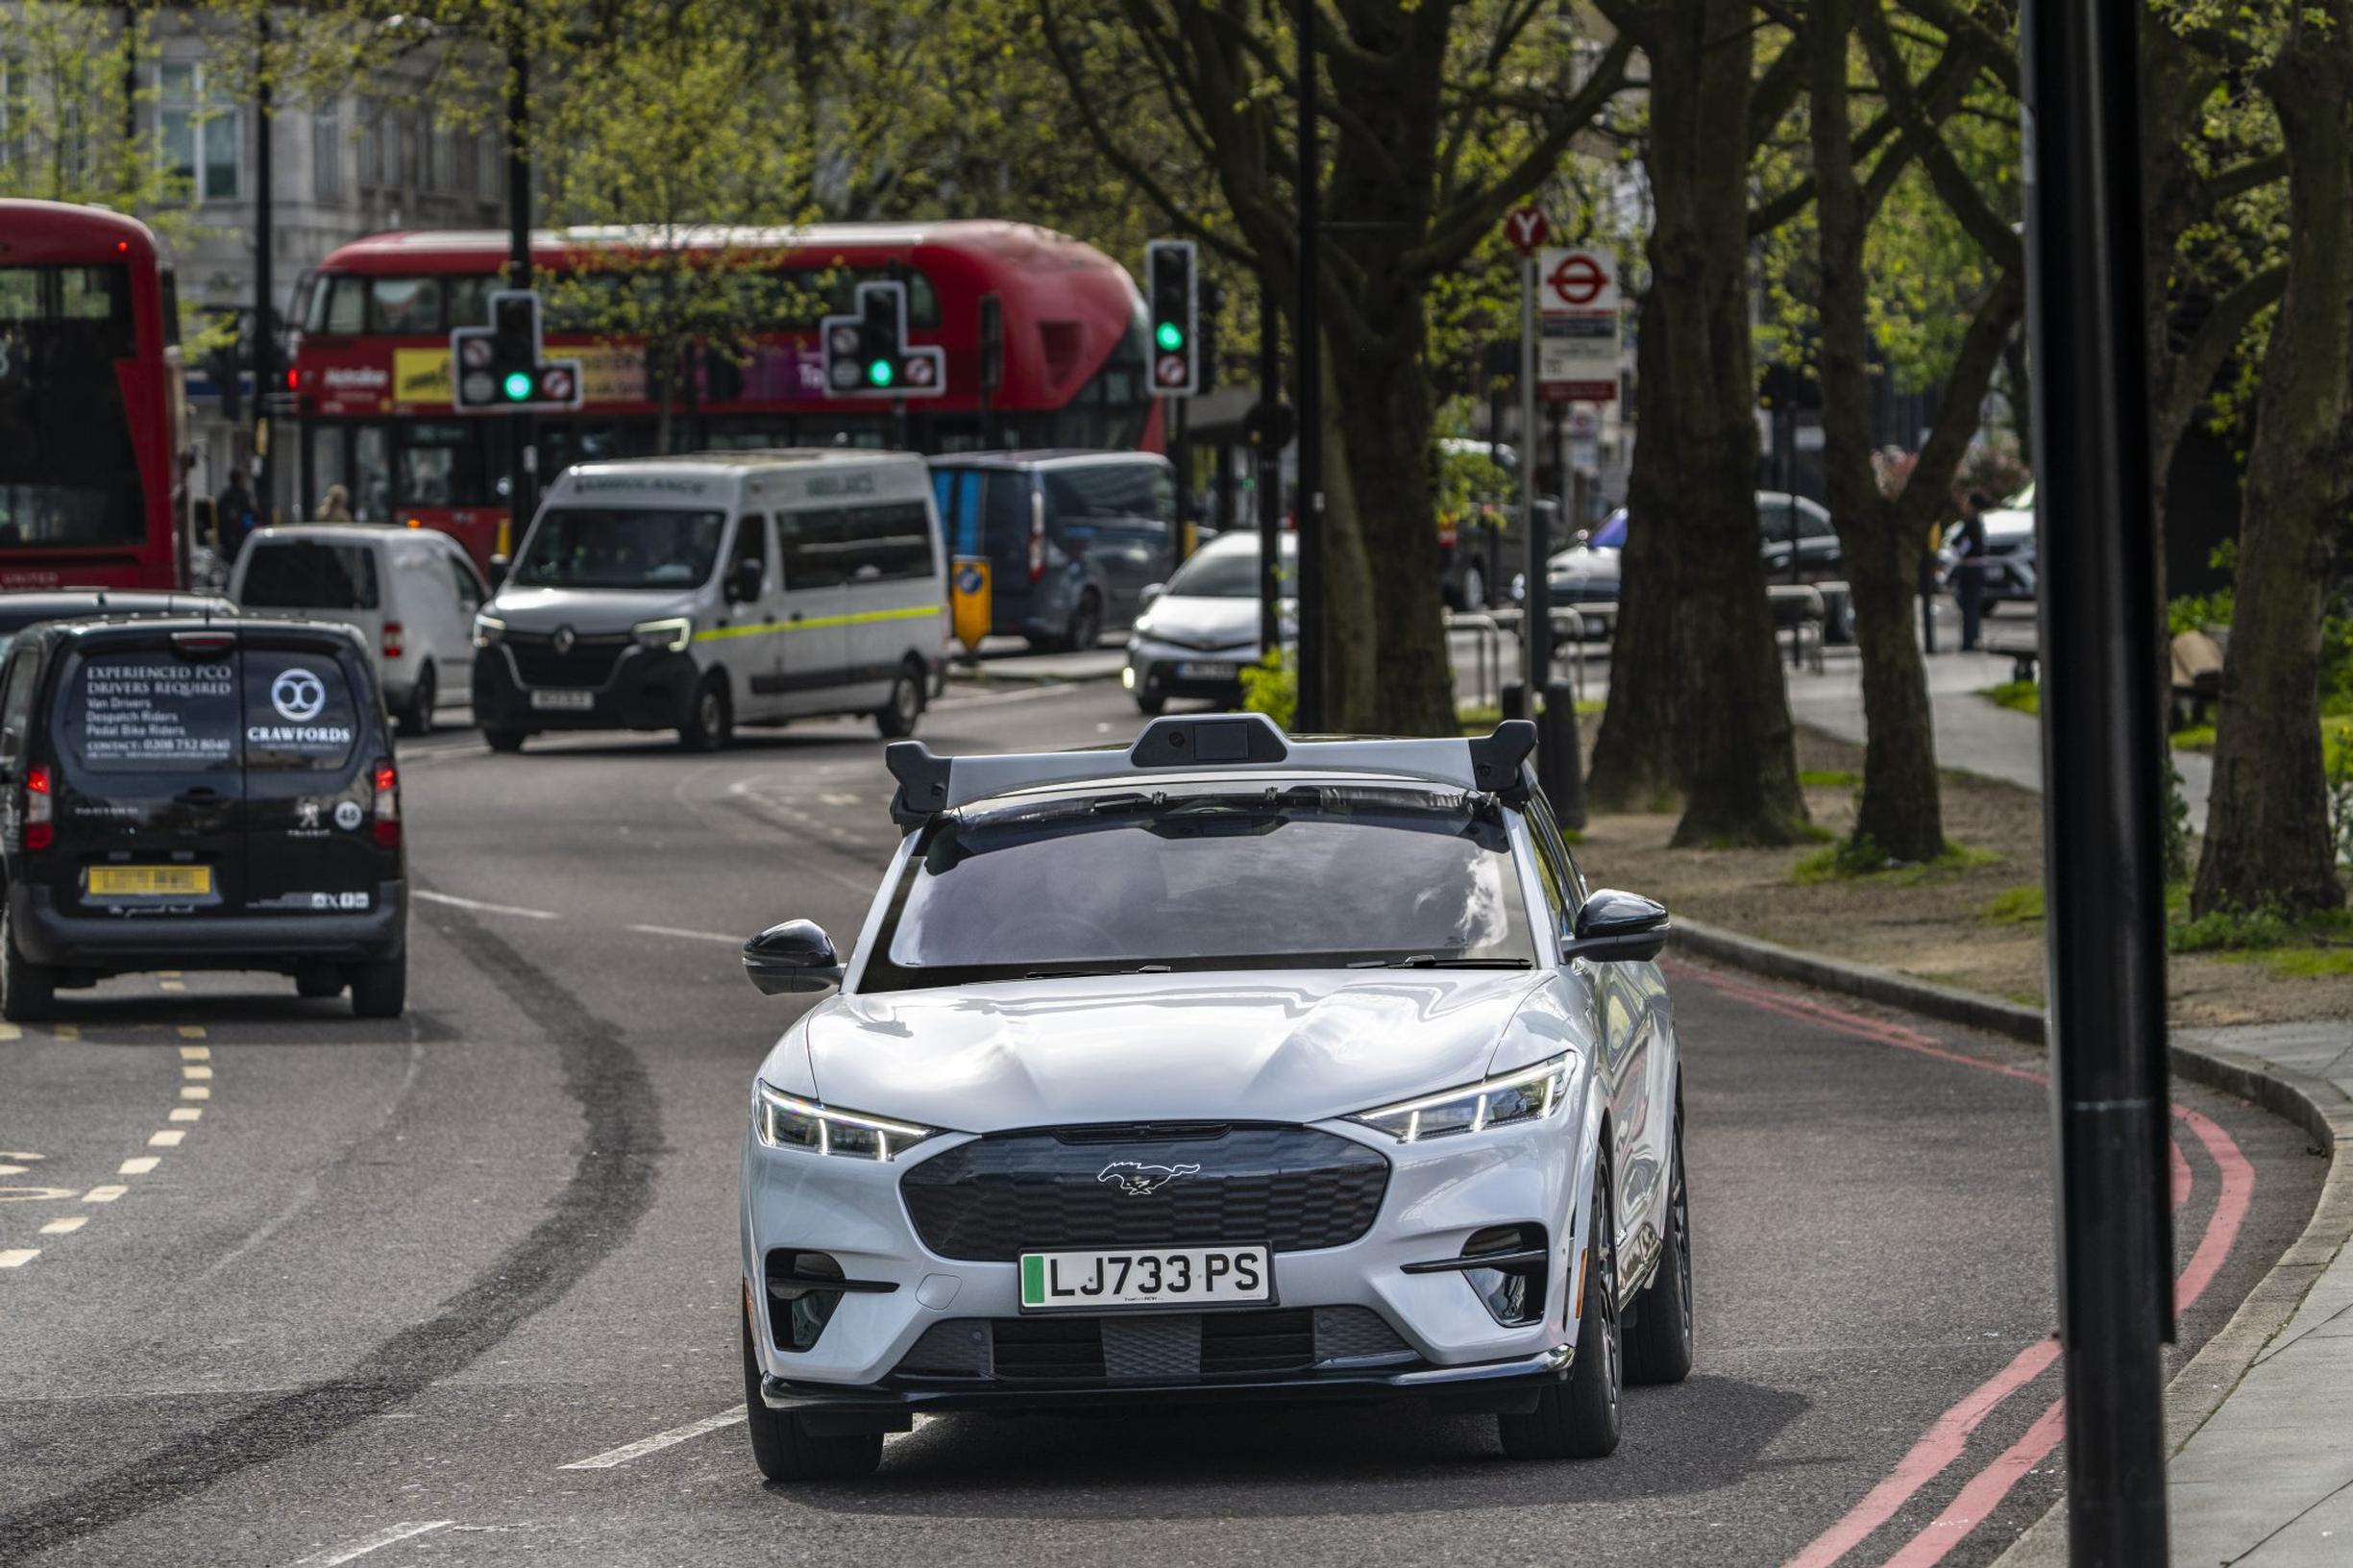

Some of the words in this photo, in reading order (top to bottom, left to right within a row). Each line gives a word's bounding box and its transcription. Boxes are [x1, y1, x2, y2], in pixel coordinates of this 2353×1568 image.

[1515, 212, 1539, 246] Y
[86, 666, 191, 679] EXPERIENCED
[195, 665, 232, 679] PCO
[86, 681, 150, 695] DRIVERS
[155, 681, 231, 697] REQUIRED
[86, 698, 109, 709] Van
[110, 697, 152, 709] Drivers
[86, 710, 139, 723] Despatch
[140, 710, 179, 723] Riders
[86, 724, 119, 736] Pedal
[120, 724, 146, 736] Bike
[148, 724, 186, 737] Riders
[247, 726, 351, 743] CRAWFORDS
[1050, 1255, 1191, 1297] LJ733
[1205, 1252, 1260, 1292] PS
